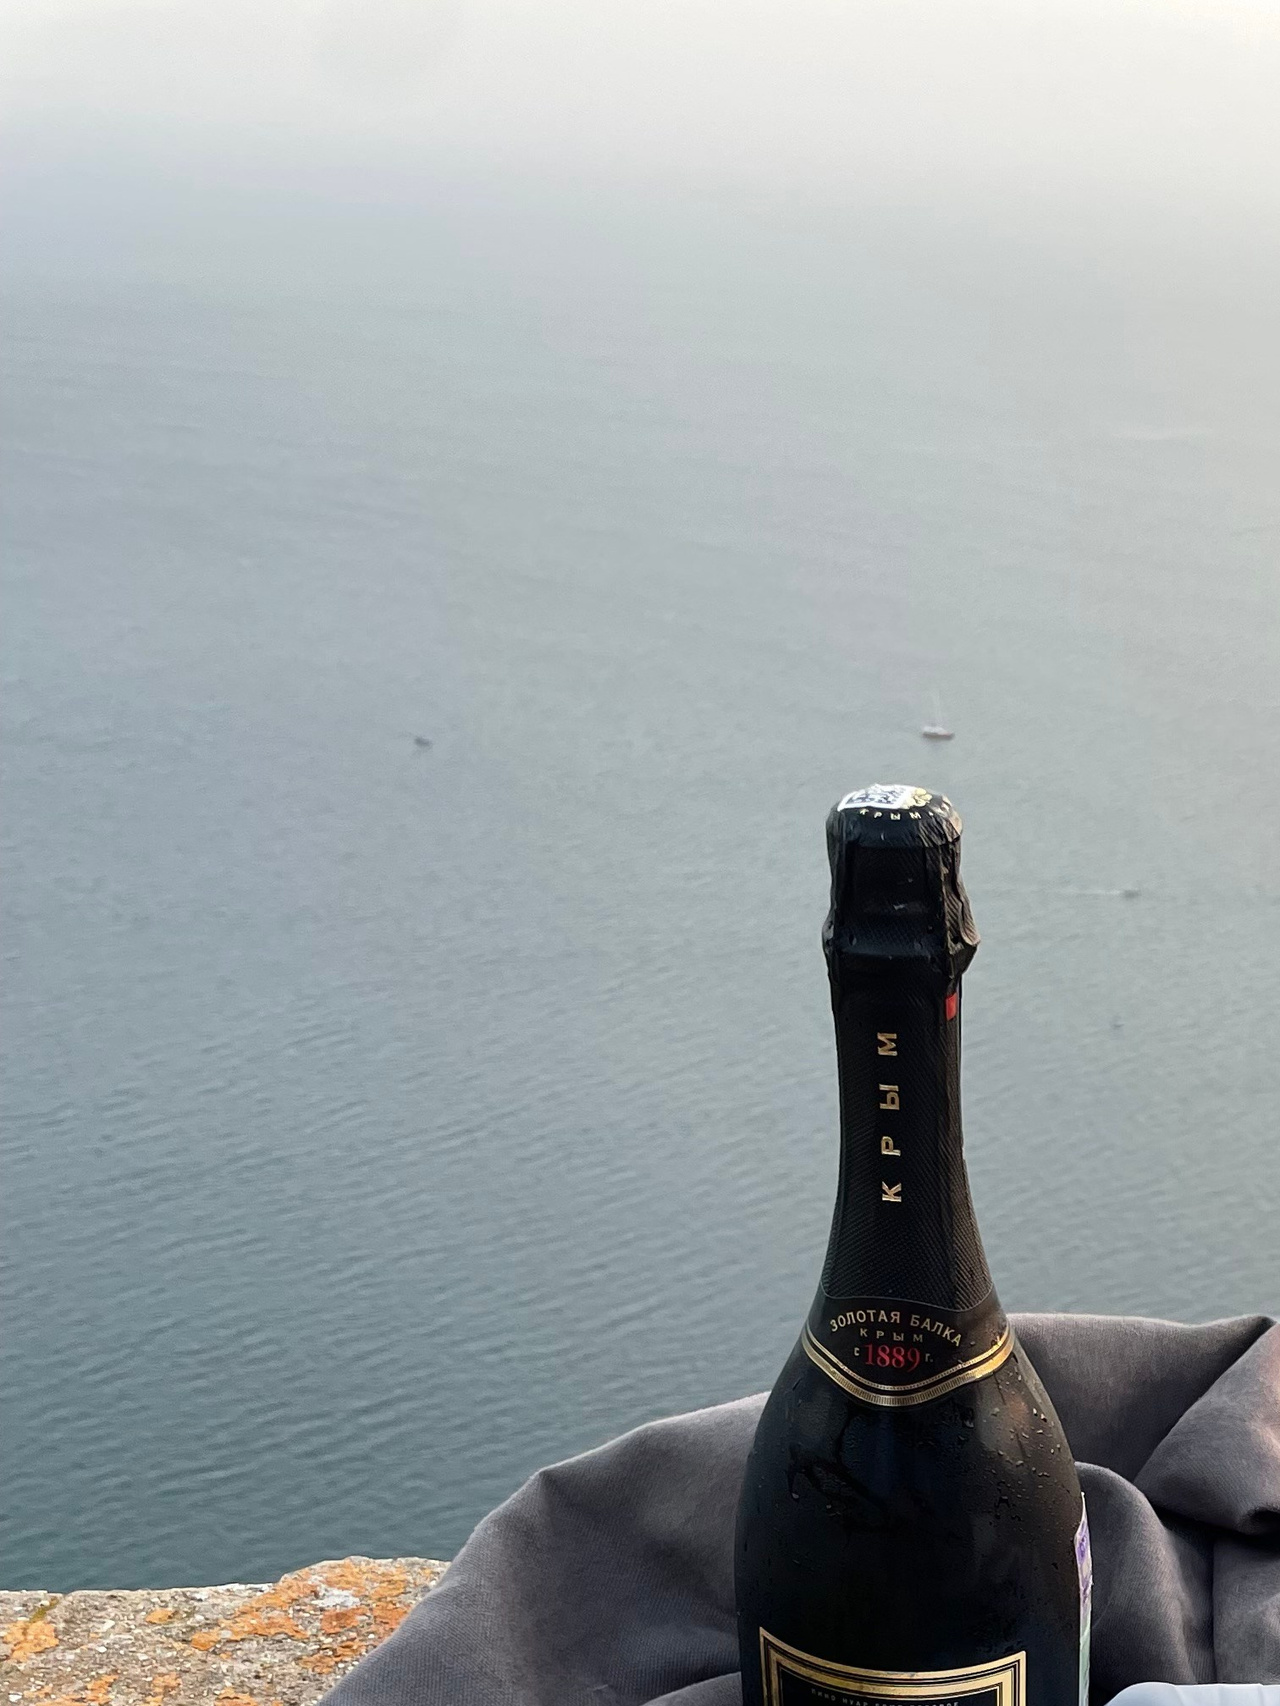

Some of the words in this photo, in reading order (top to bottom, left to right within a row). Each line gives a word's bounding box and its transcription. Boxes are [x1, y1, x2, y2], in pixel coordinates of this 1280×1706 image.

[877, 1032, 902, 1202] КРЫМ
[829, 1309, 901, 1332] ЗОЛОТАЯ
[910, 1314, 963, 1347] БАЛКА
[859, 1327, 924, 1343] КРЫМ
[864, 1341, 921, 1373] 1889
